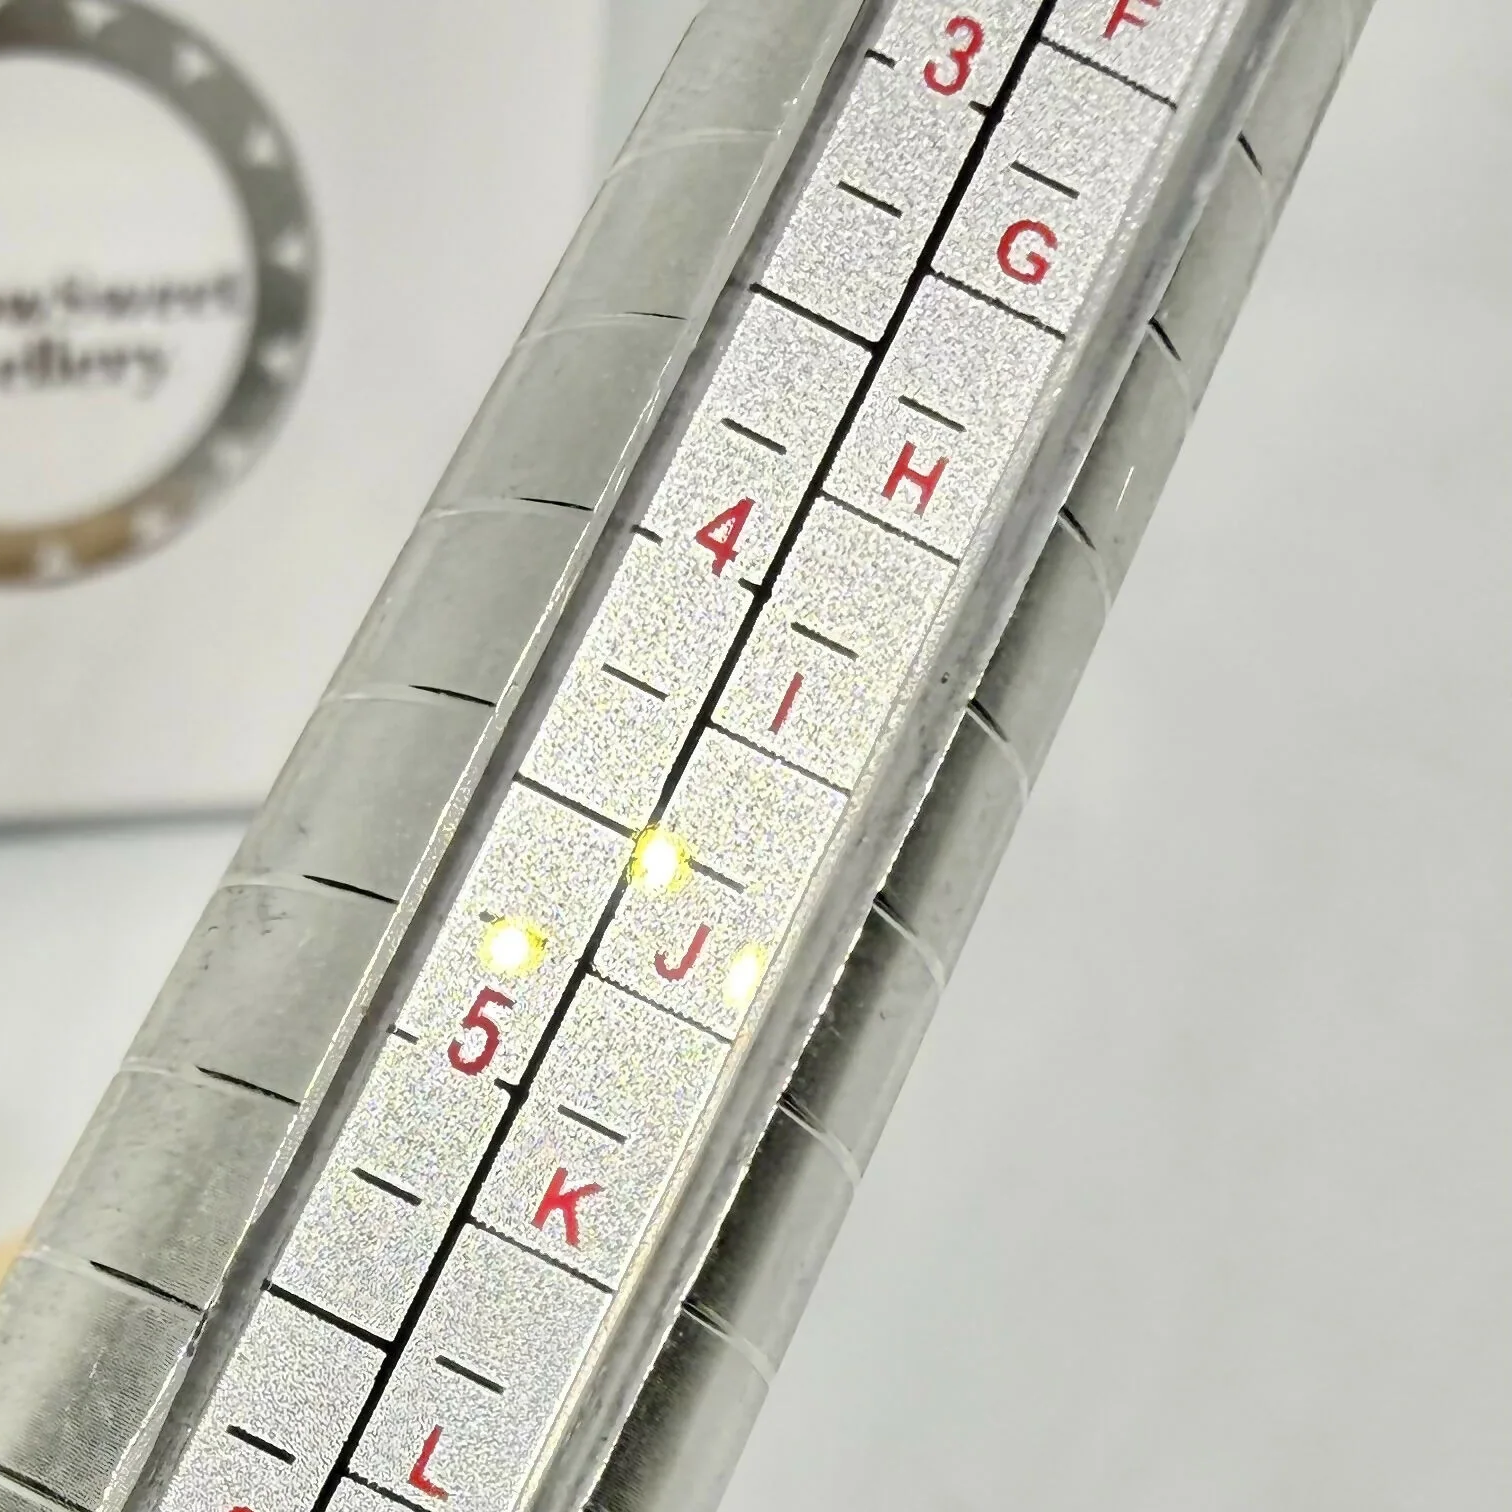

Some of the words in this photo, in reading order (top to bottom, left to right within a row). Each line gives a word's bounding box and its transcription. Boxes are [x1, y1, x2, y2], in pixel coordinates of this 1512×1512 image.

[922, 15, 985, 96] 3
[996, 219, 1058, 285] G
[881, 441, 949, 517] H
[695, 497, 754, 576] 4
[769, 673, 803, 732] I
[652, 925, 708, 980] J
[447, 987, 514, 1074] 5
[532, 1167, 606, 1247] K
[407, 1427, 447, 1499] L
